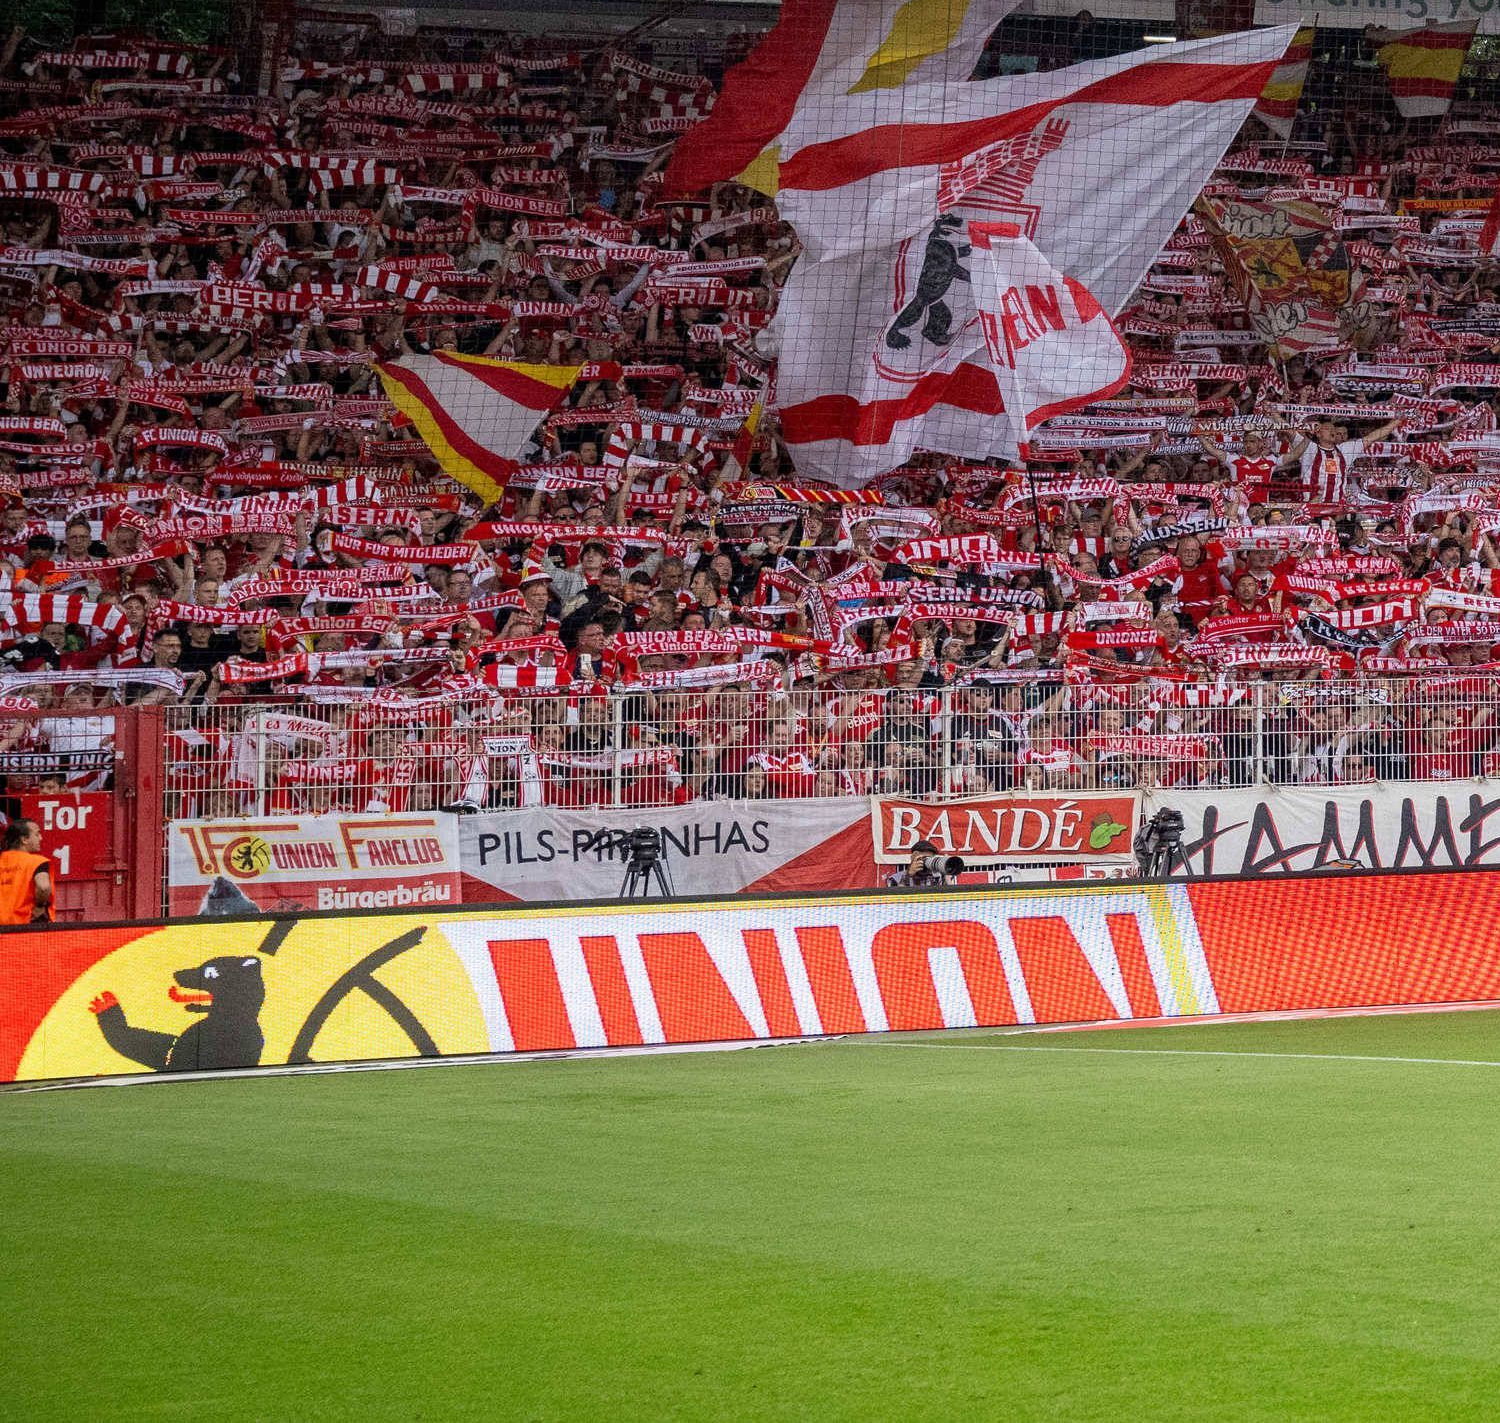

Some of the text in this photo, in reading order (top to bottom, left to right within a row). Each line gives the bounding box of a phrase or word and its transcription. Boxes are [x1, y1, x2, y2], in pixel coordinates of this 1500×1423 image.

[519, 301, 574, 317] UNION
[35, 341, 93, 357] UNION
[156, 427, 201, 444] UNION
[1128, 419, 1164, 431] BERLIN
[240, 493, 302, 514] UNION
[154, 515, 223, 538] UNION
[334, 533, 475, 560] NUR FÜR MITGLIEDER!
[102, 547, 155, 568] UNION
[347, 565, 408, 581] BERLIN
[979, 587, 1047, 609] UNION
[283, 615, 357, 634] FC Union
[626, 630, 668, 646] UNION
[639, 639, 739, 654] FC Union Berlin
[1095, 629, 1159, 646] UNIONER
[846, 711, 880, 730] BERLIN
[38, 798, 93, 832] Tor
[888, 800, 1086, 853] BANDÉ
[478, 819, 770, 867] PILS-PIRNHAS
[53, 846, 71, 877] 1
[272, 840, 337, 870] UNION
[317, 879, 451, 911] Bürgerbräu
